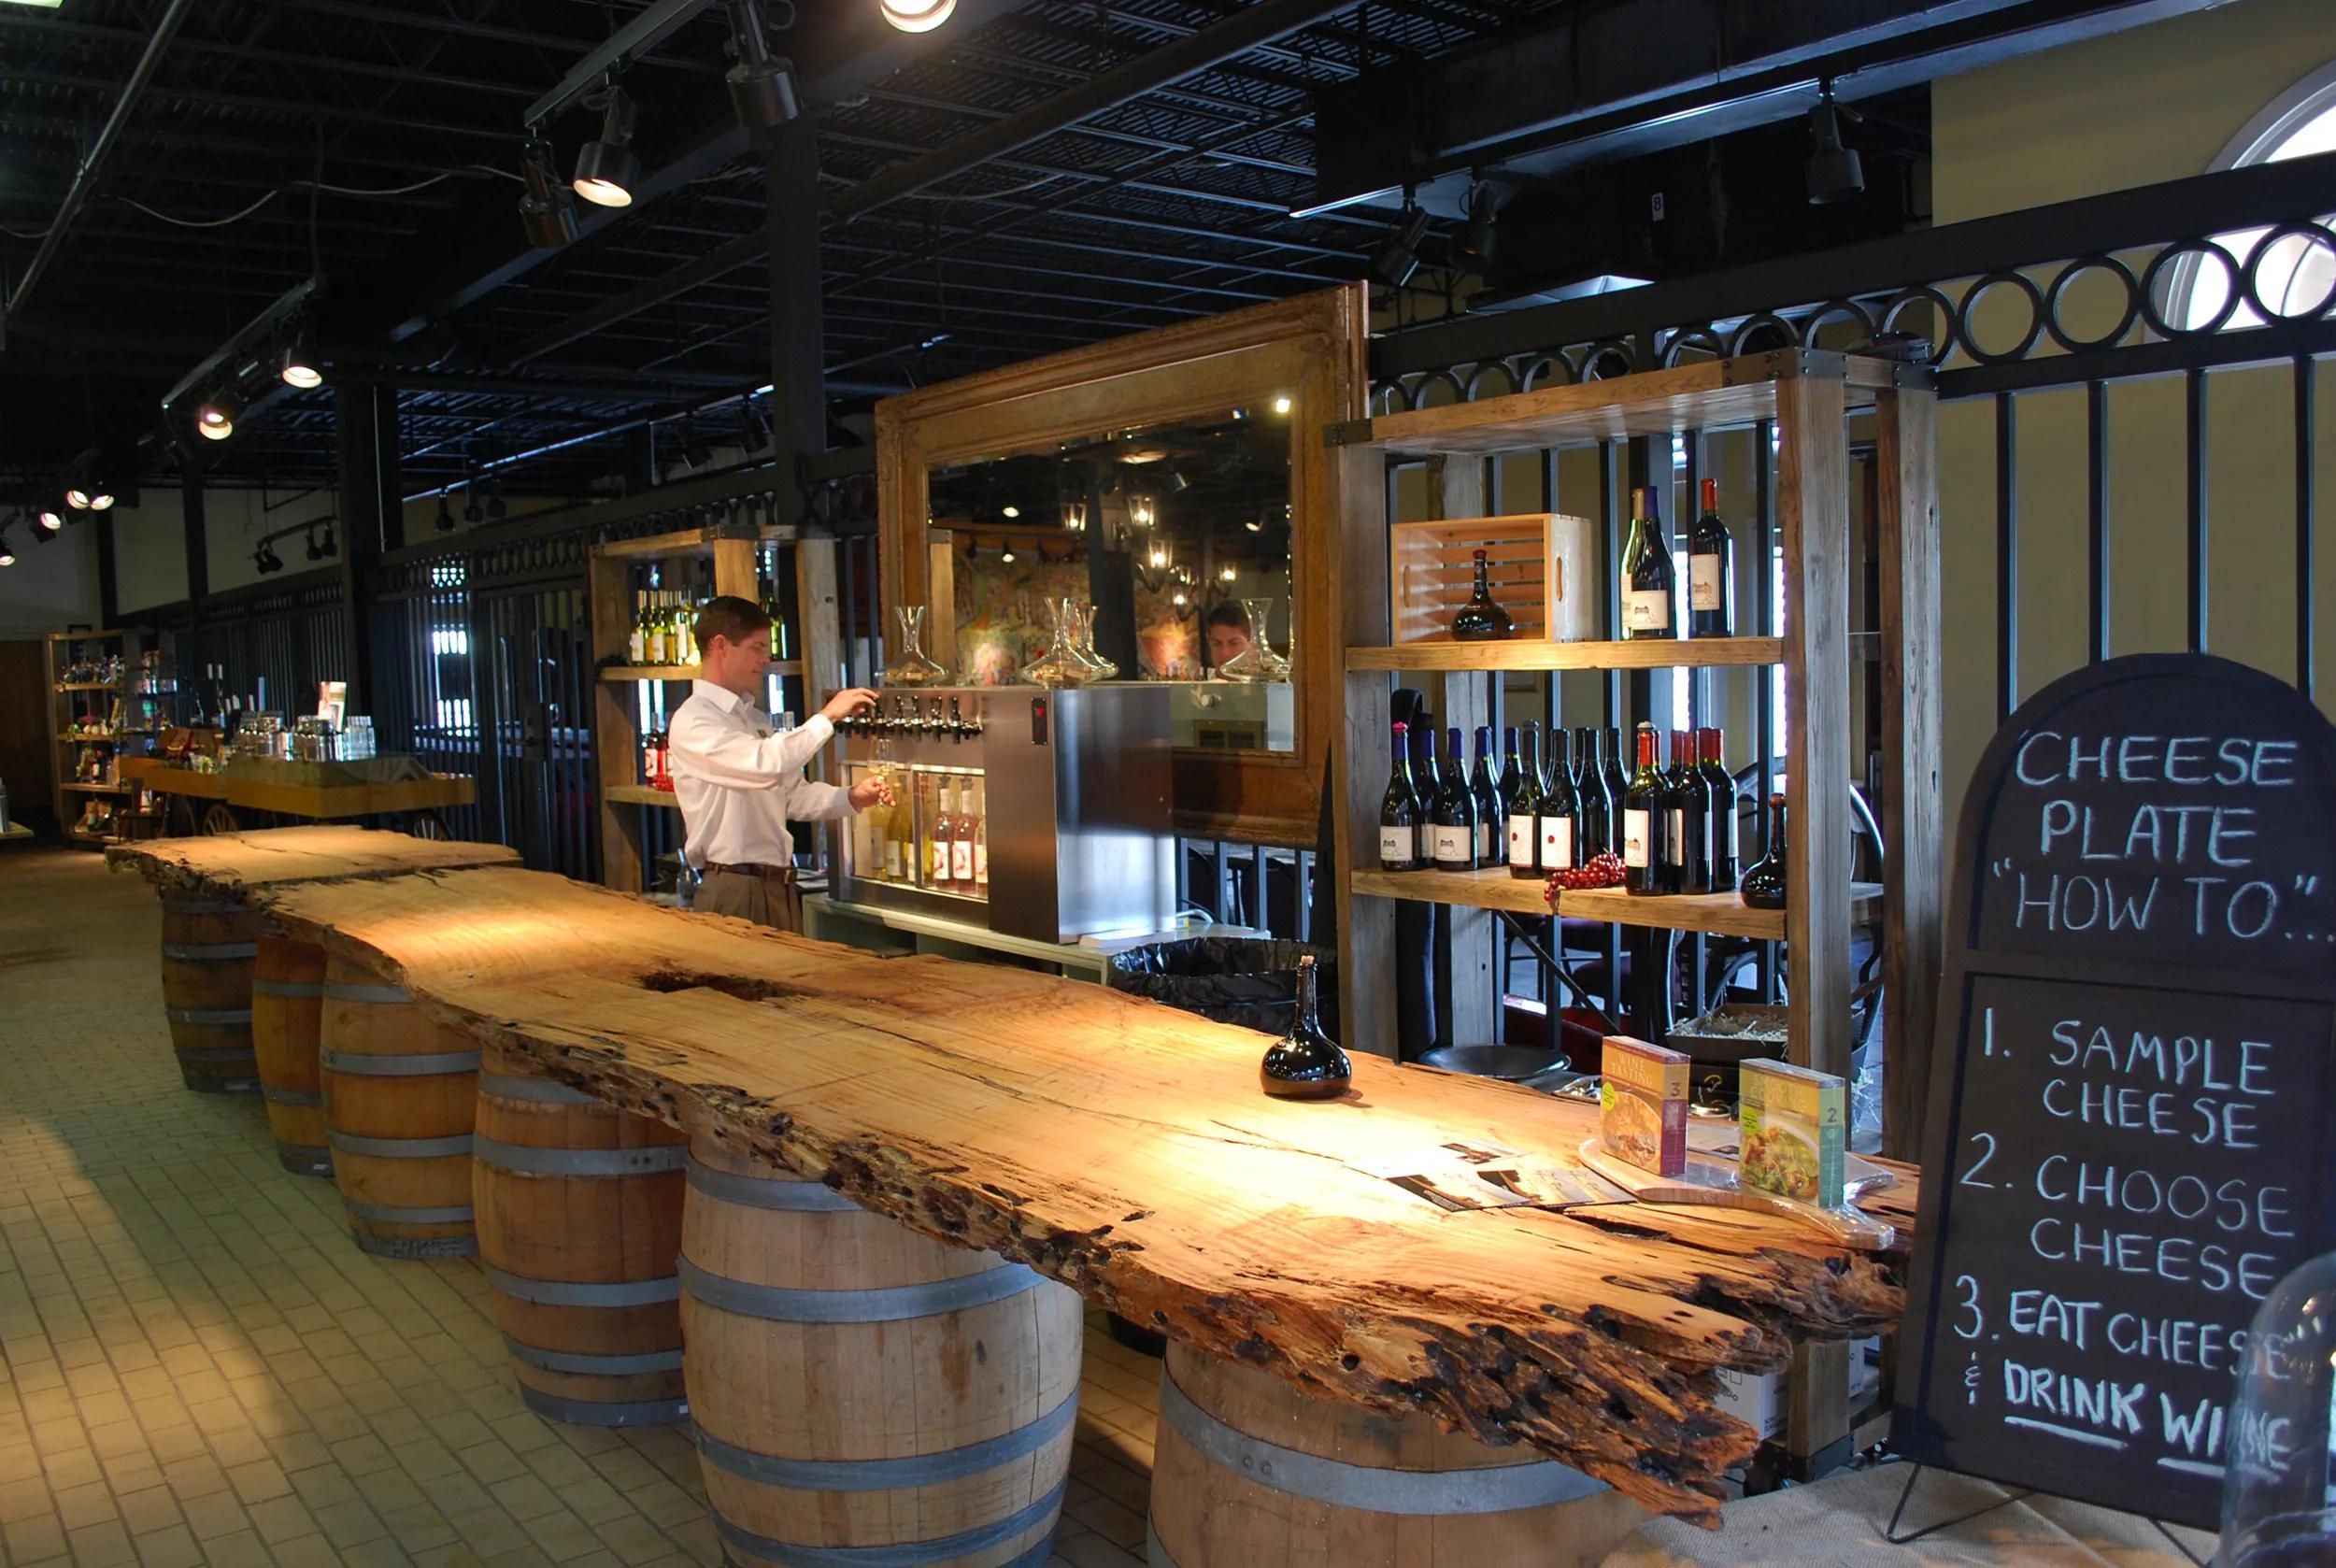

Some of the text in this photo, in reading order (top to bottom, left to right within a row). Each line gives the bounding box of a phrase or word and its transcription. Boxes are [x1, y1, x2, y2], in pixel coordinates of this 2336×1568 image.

[1654, 196, 1661, 211] 8
[2016, 731, 2298, 786] CHEESE
[2041, 799, 2257, 867] PLATE
[1985, 1006, 2011, 1057] 1.
[2048, 1019, 2276, 1095] SAMPLE
[1610, 1062, 1653, 1085] TASTING
[1617, 1053, 1645, 1073] WINE
[1670, 1082, 1680, 1097] 3
[1828, 1107, 1837, 1123] 2
[2043, 1078, 2259, 1148] CHEESE
[1959, 1132, 2014, 1189] 2.
[2035, 1155, 2295, 1237] CHOOSE
[2030, 1218, 2277, 1301] CHEESE
[1953, 1275, 2001, 1339] 3.
[2009, 1289, 2291, 1381] EAT CHEESE
[2002, 1358, 2291, 1472] DRINK WINE
